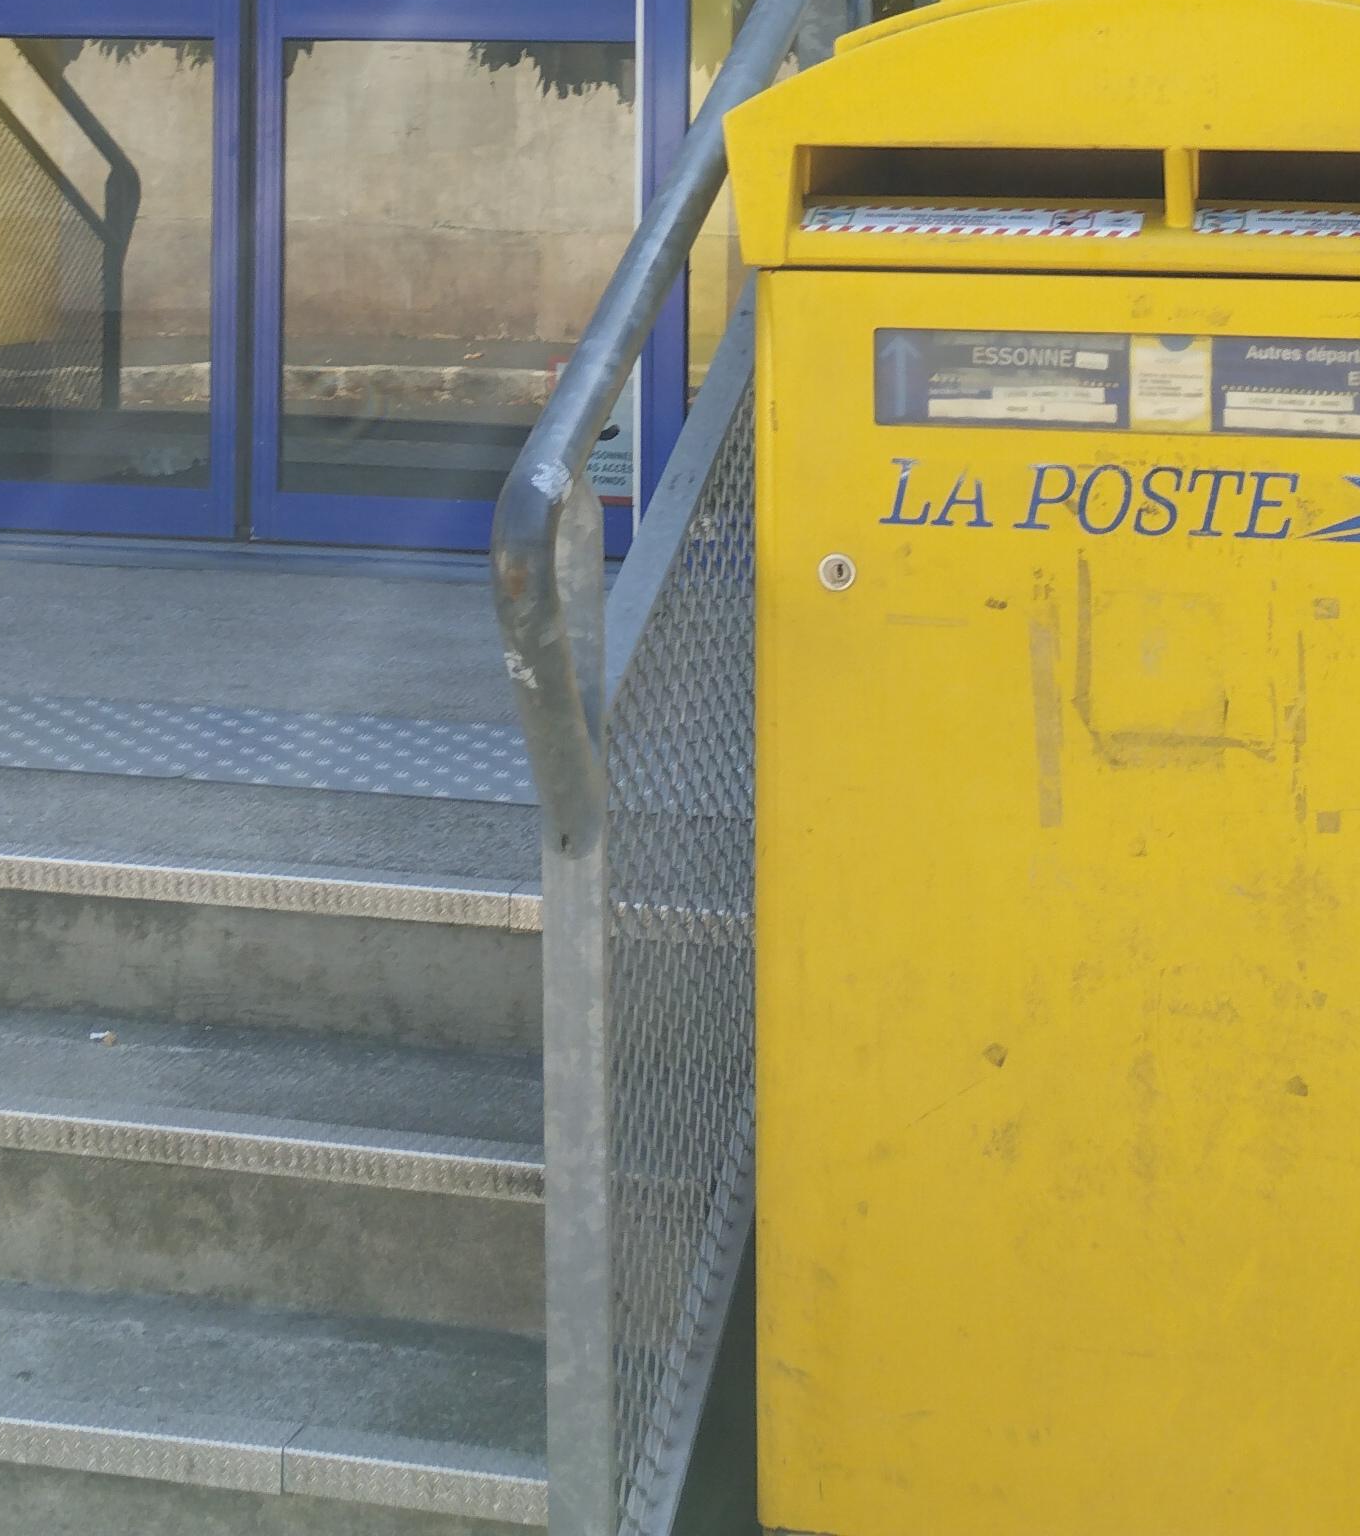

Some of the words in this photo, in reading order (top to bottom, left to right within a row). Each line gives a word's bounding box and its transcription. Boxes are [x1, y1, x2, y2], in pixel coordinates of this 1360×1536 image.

[971, 345, 1073, 367] ESSONNE
[1245, 345, 1301, 362] Autres
[878, 458, 994, 528] LA
[1013, 462, 1300, 540] POSTE
